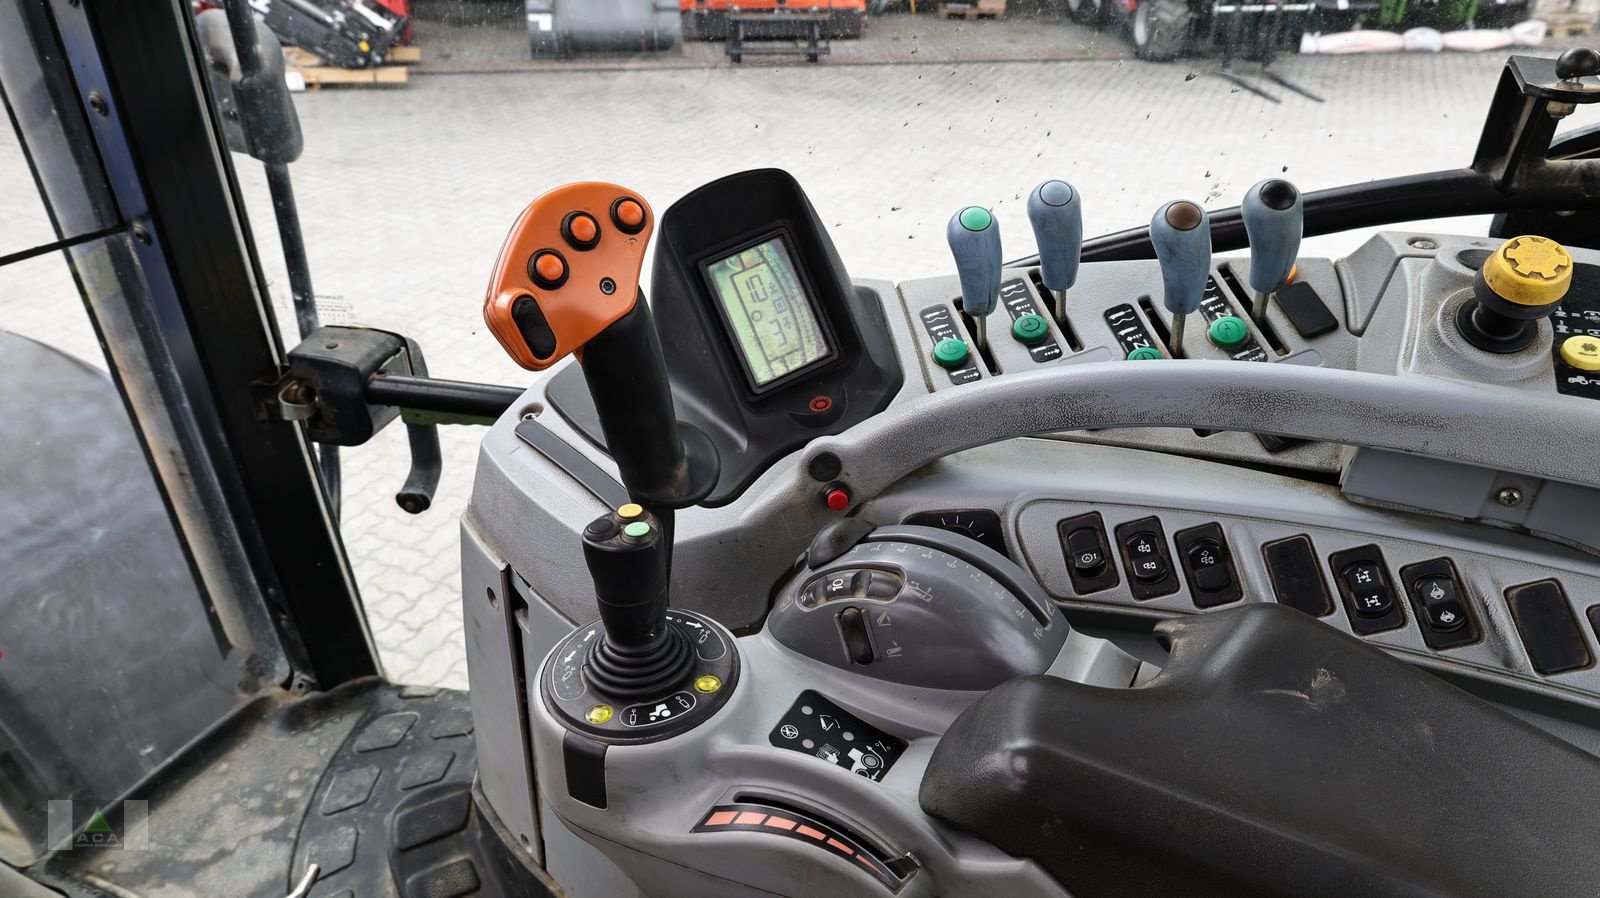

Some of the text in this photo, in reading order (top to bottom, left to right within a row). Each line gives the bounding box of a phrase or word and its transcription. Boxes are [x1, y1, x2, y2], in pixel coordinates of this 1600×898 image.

[946, 561, 956, 569] 6
[832, 578, 844, 592] 10
[1033, 627, 1042, 640] 10
